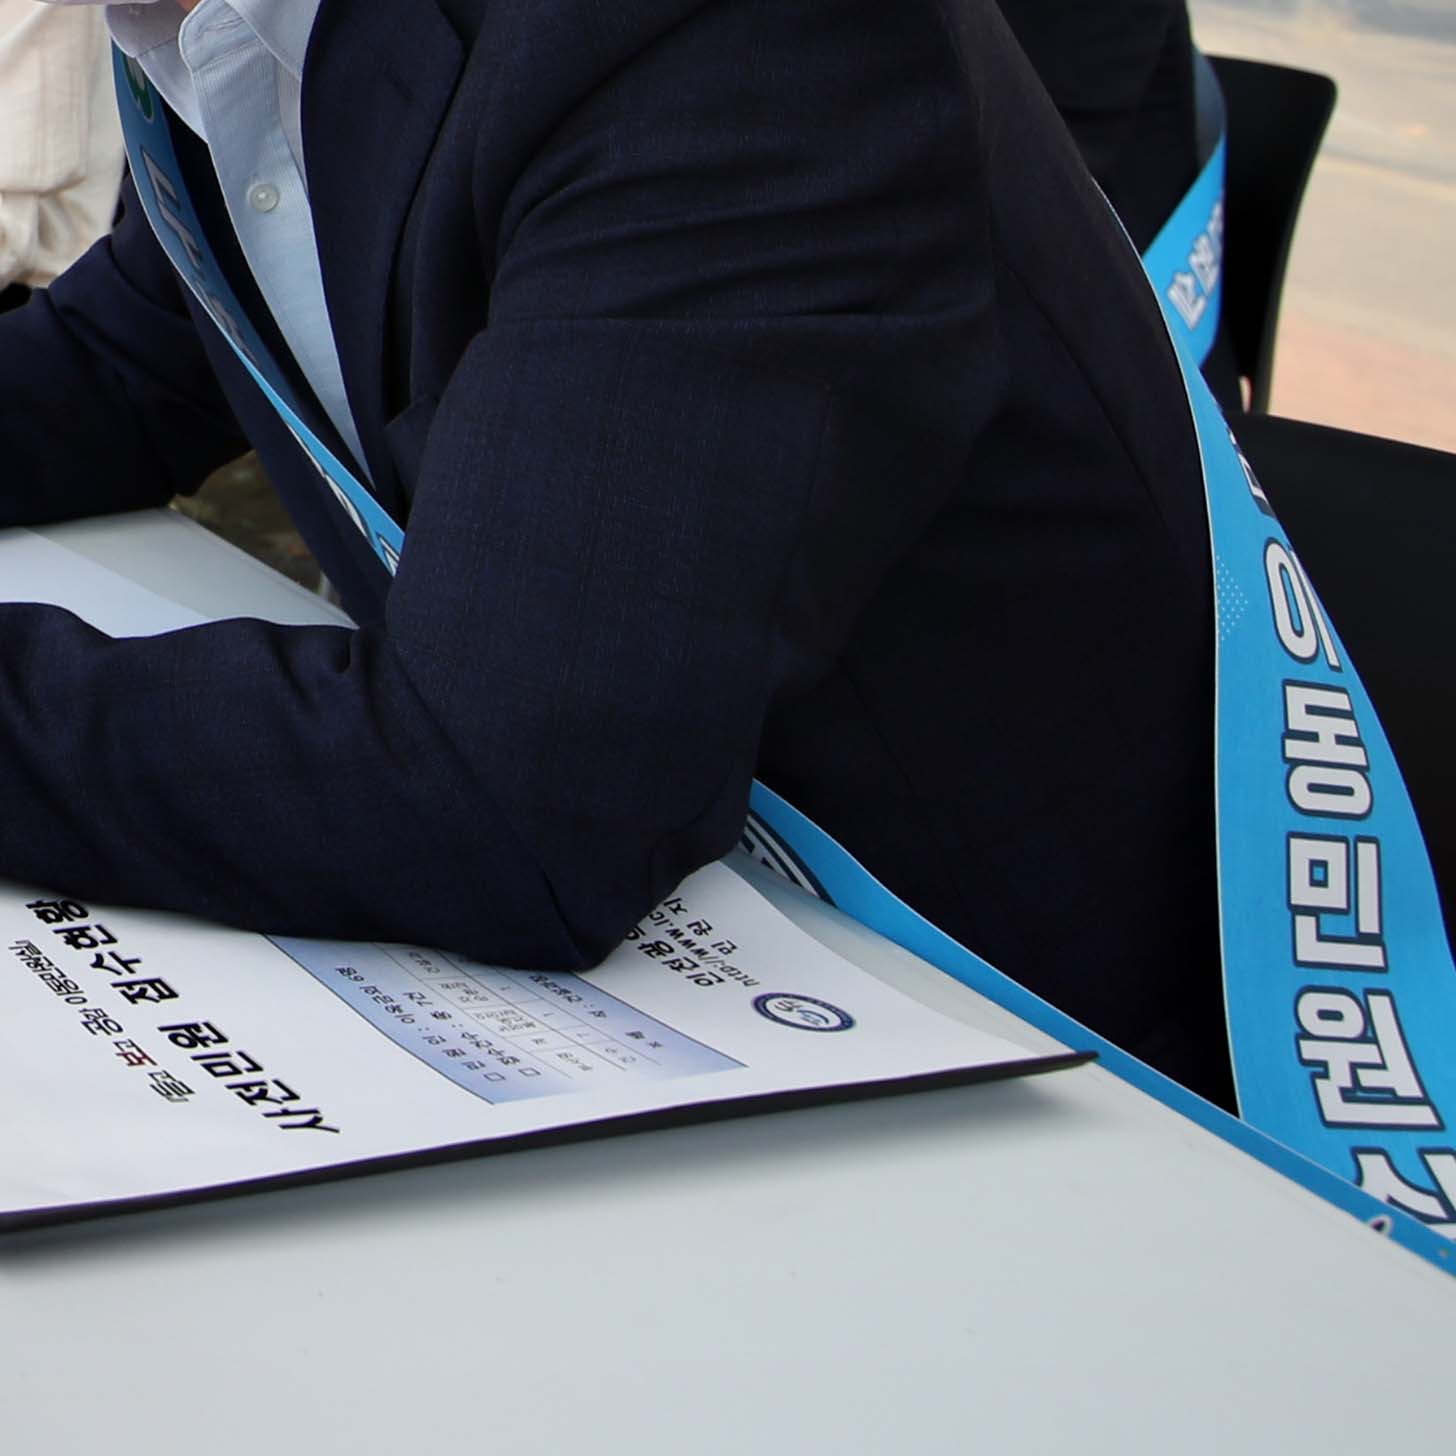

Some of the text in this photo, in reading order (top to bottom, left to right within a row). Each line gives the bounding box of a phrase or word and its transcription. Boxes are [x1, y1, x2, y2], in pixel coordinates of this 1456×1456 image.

[25, 899, 340, 1133] 사전민원 접수현황
[78, 1007, 124, 1036] 공감
[112, 1038, 158, 1067] 보고
